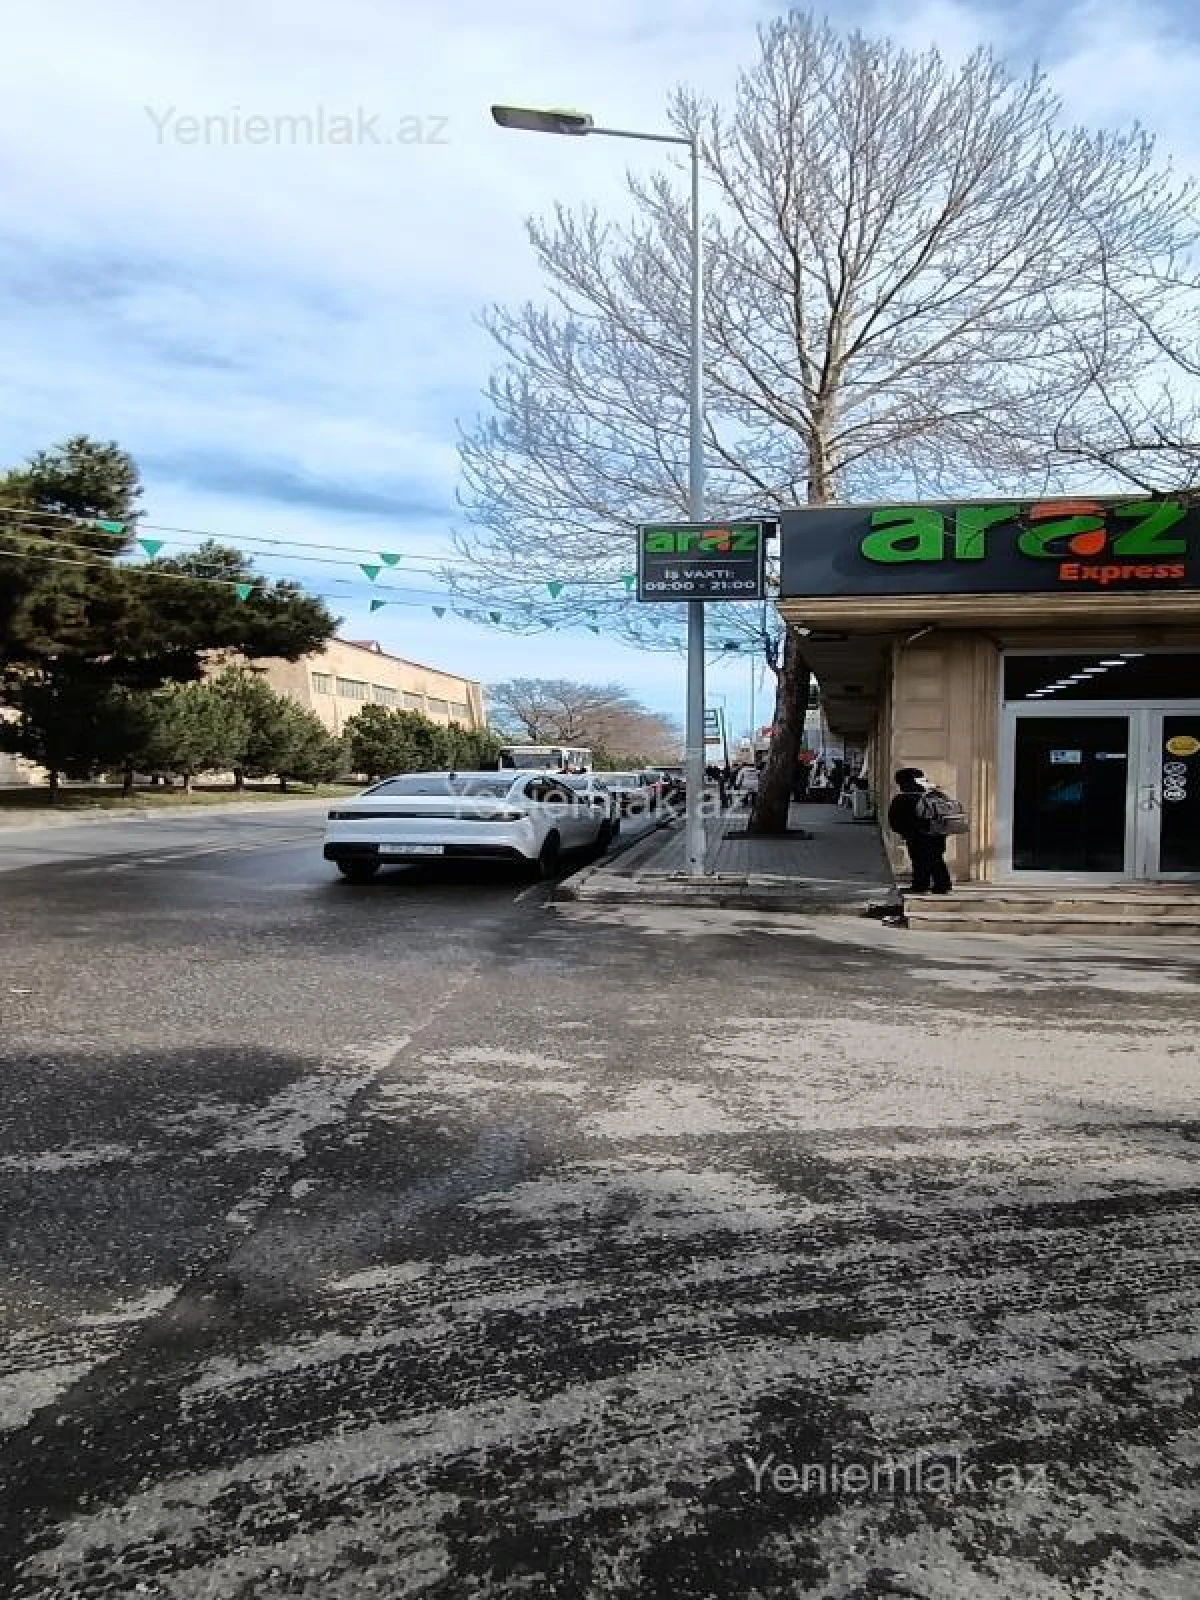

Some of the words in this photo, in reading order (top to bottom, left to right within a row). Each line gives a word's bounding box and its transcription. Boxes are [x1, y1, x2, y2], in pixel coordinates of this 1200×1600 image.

[646, 529, 757, 553] araz
[861, 500, 1186, 562] araz
[1059, 563, 1184, 583] Express
